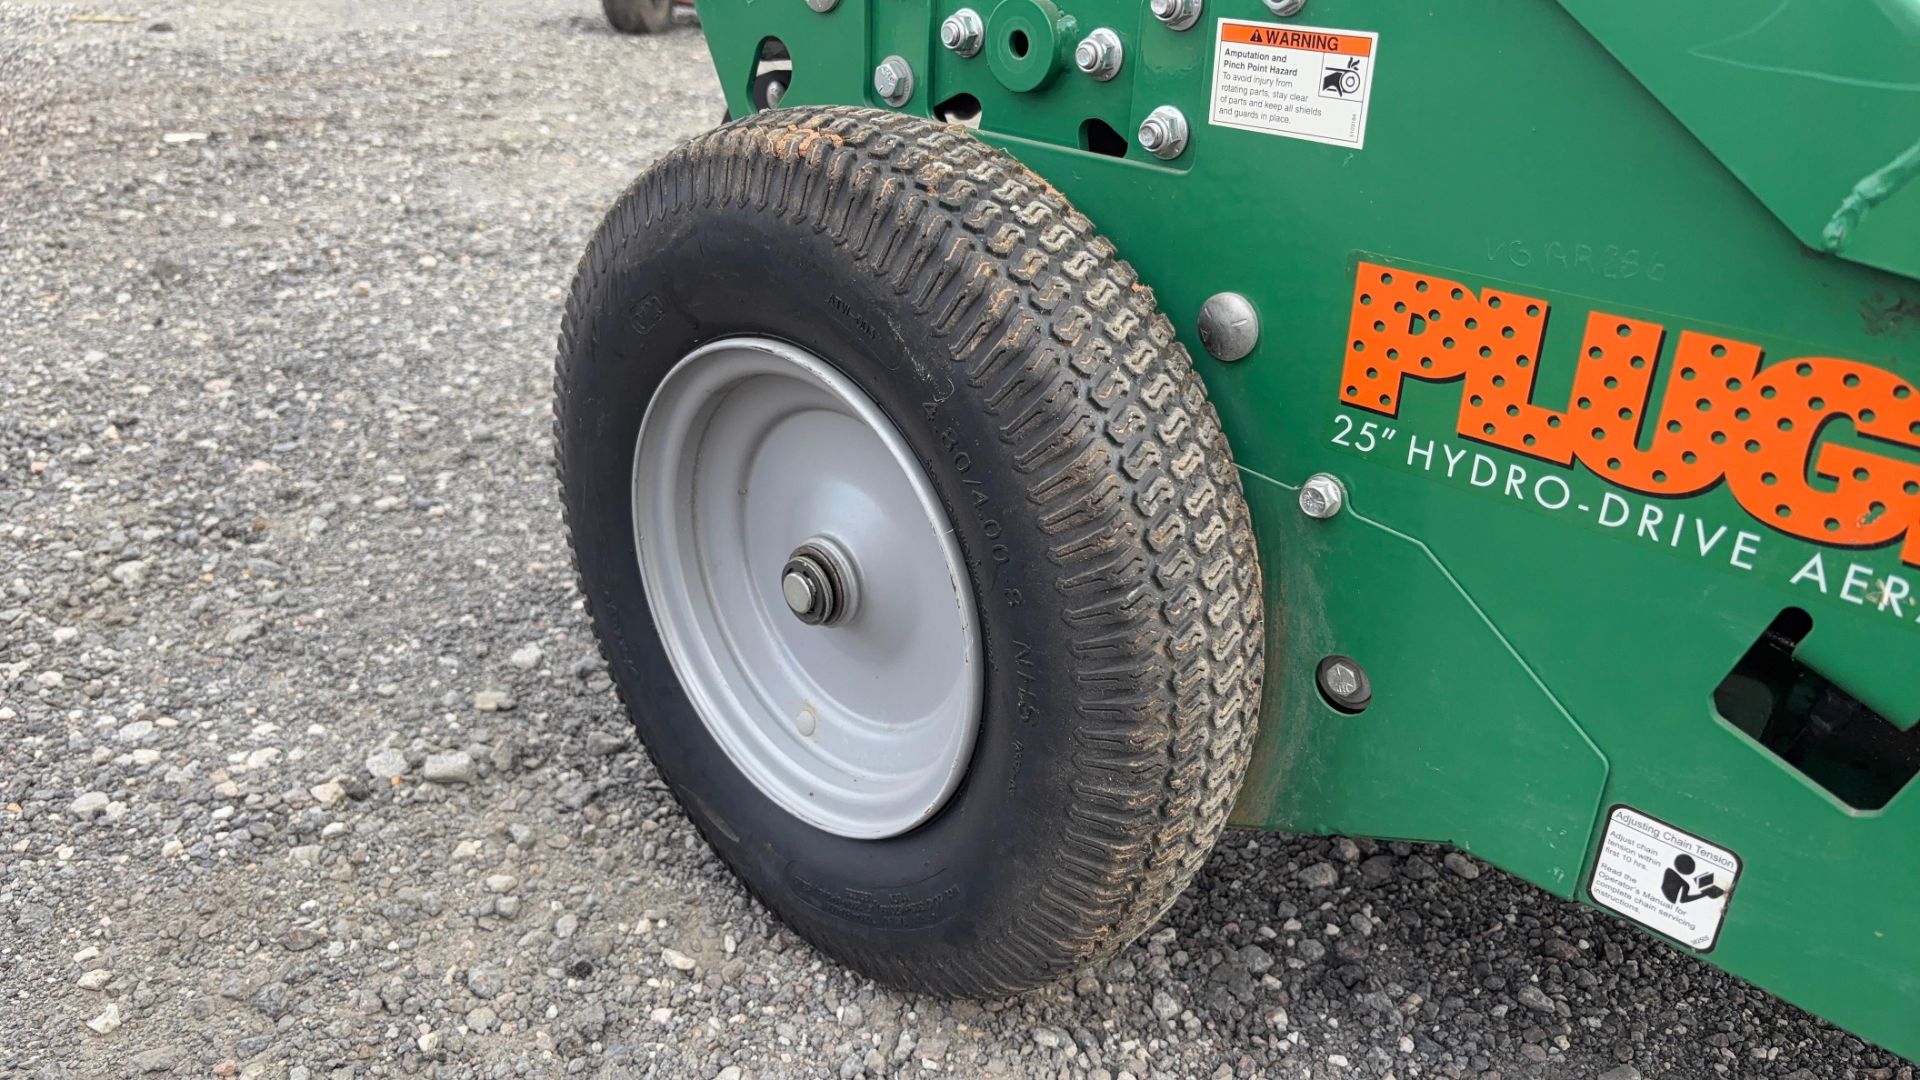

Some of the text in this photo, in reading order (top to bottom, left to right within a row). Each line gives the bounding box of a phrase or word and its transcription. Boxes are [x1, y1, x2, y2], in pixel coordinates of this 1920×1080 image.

[1266, 30, 1339, 51] WARNING
[1225, 48, 1287, 63] Amputation and
[1223, 72, 1293, 88] To avoid injury from
[1224, 60, 1298, 76] Pinch Point Hazard
[1222, 85, 1308, 102] rotating parts, stay clear
[1219, 107, 1232, 116] and
[1234, 110, 1258, 120] guards
[1269, 114, 1291, 124] place.
[1220, 96, 1322, 116] of parts and keep all shields
[1338, 261, 1920, 568] PLUG
[1407, 435, 1762, 572] HYDRO-DRIVE
[1790, 552, 1920, 618] AER
[1609, 830, 1658, 856] Adjust chain
[1616, 811, 1735, 868] Adjusting Chain Tension
[1605, 847, 1648, 871] first 10 hrs.
[1607, 839, 1661, 867] tension within
[1601, 862, 1638, 883] Read the
[1594, 887, 1641, 914] instructions.
[1595, 879, 1696, 931] complete chain servicing
[1642, 891, 1674, 909] Manual
[1675, 906, 1687, 916] for
